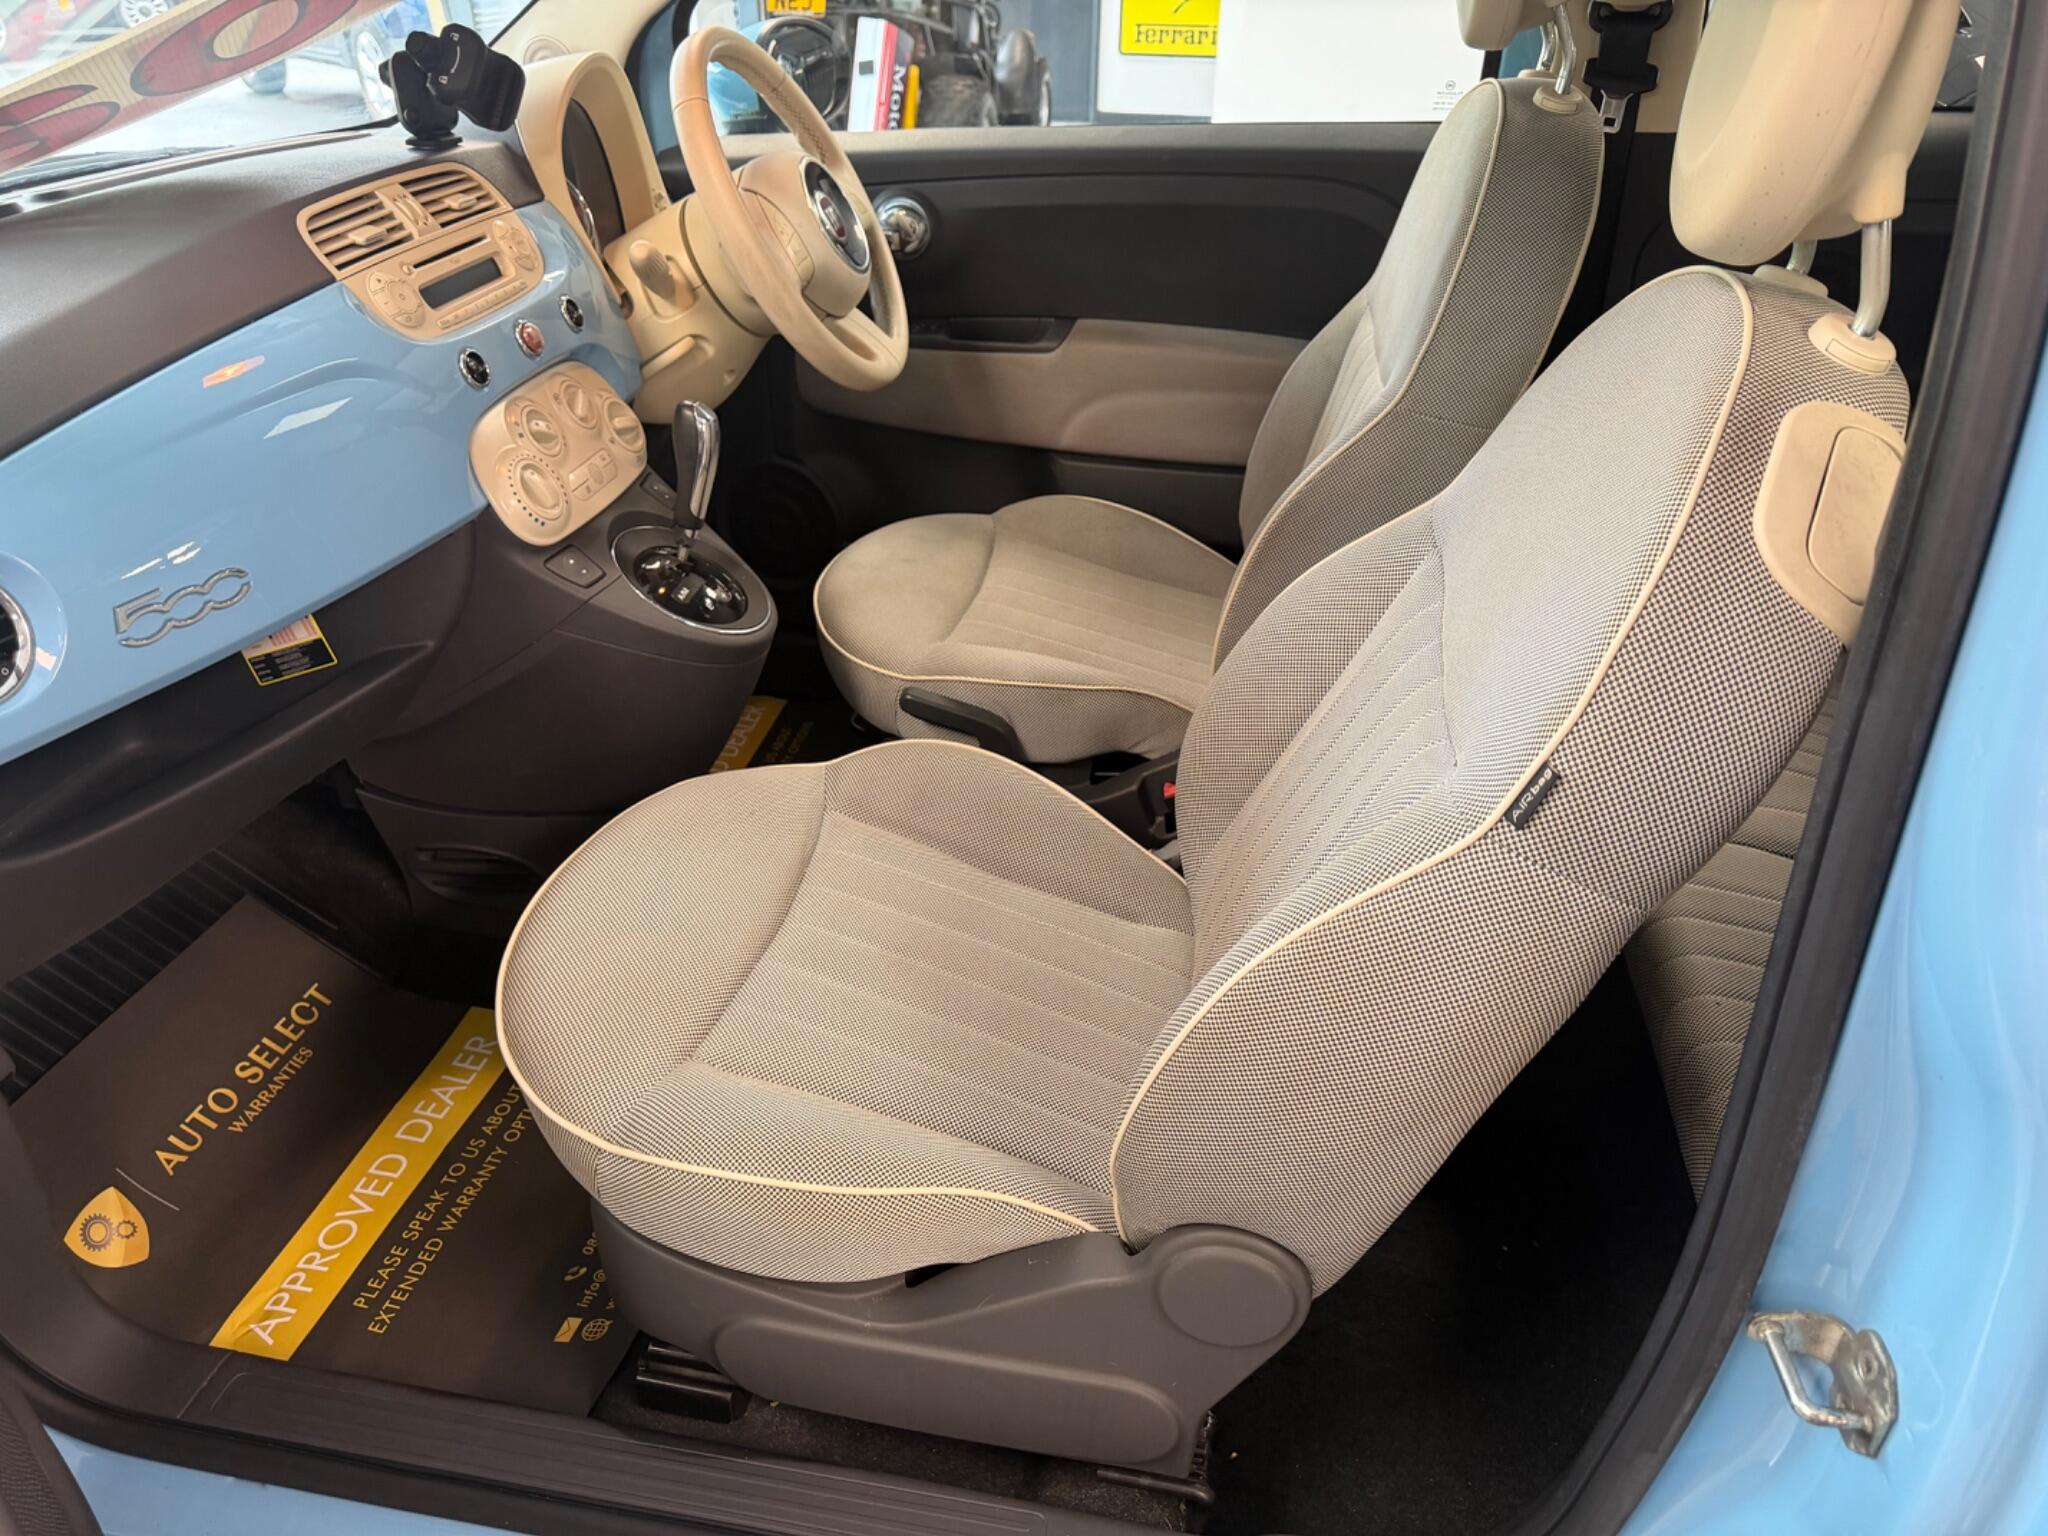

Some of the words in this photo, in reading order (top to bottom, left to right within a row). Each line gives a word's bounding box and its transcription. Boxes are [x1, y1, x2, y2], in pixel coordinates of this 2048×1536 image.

[1135, 22, 1217, 46] Ferrari
[112, 566, 254, 648] 500
[155, 1087, 239, 1176] AUTO
[234, 982, 333, 1084] SELECT
[227, 1046, 314, 1133] WARRANTIES
[250, 1153, 409, 1346] APPROVED
[395, 1035, 497, 1144] DEALER
[353, 1245, 408, 1309] PLEASE
[402, 1190, 448, 1241] SPEAK
[441, 1162, 467, 1186] TO
[461, 1137, 486, 1159] US
[483, 1083, 521, 1136] ABOUT
[367, 1237, 444, 1335] EXTENDED
[436, 1146, 508, 1233] WARRANTY
